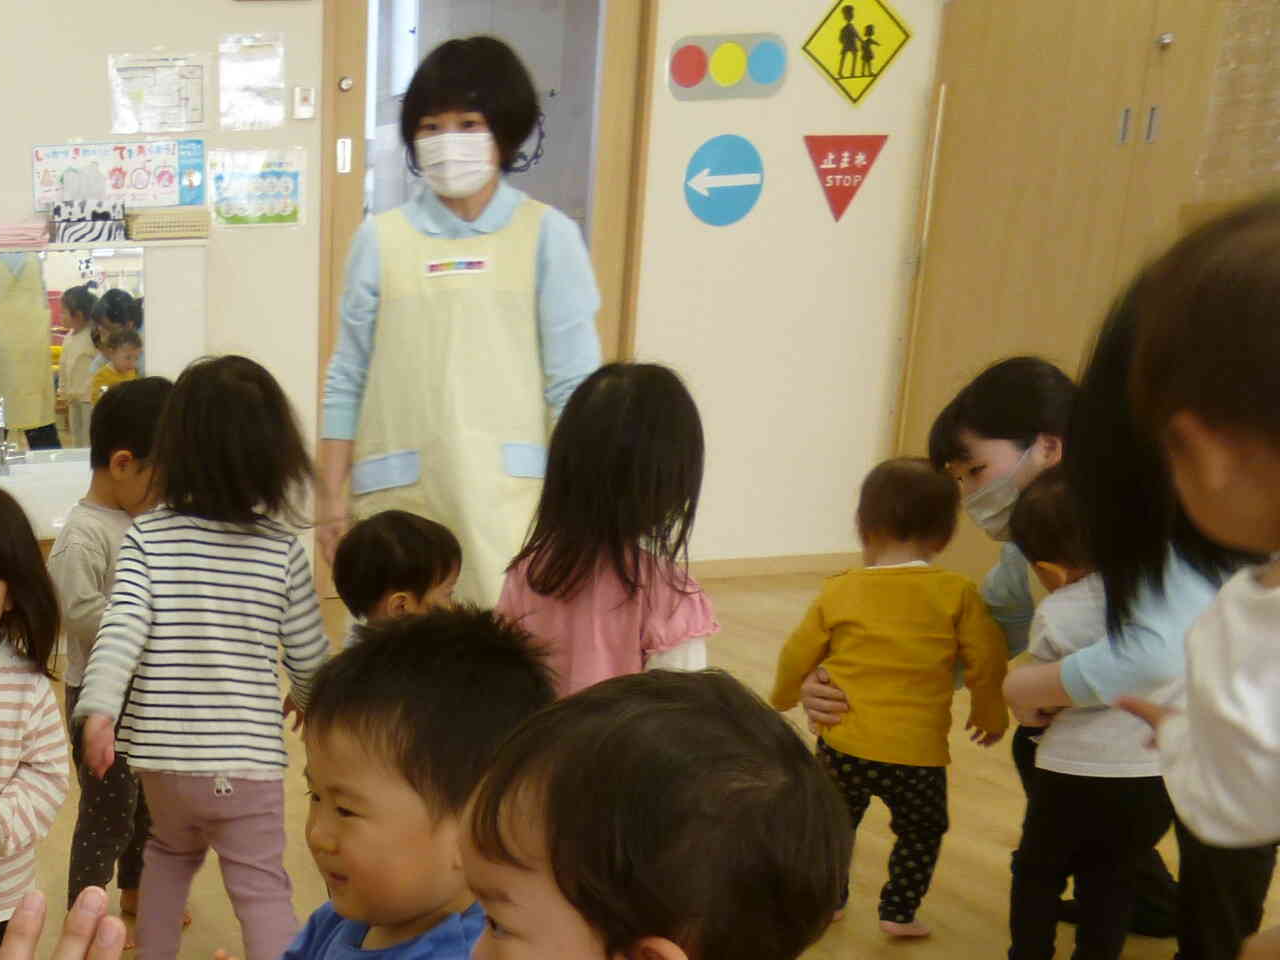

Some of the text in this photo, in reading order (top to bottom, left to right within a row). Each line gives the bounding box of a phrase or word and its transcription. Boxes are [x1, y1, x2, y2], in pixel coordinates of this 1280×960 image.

[820, 151, 867, 168] 止まれ
[824, 175, 863, 187] STOP
